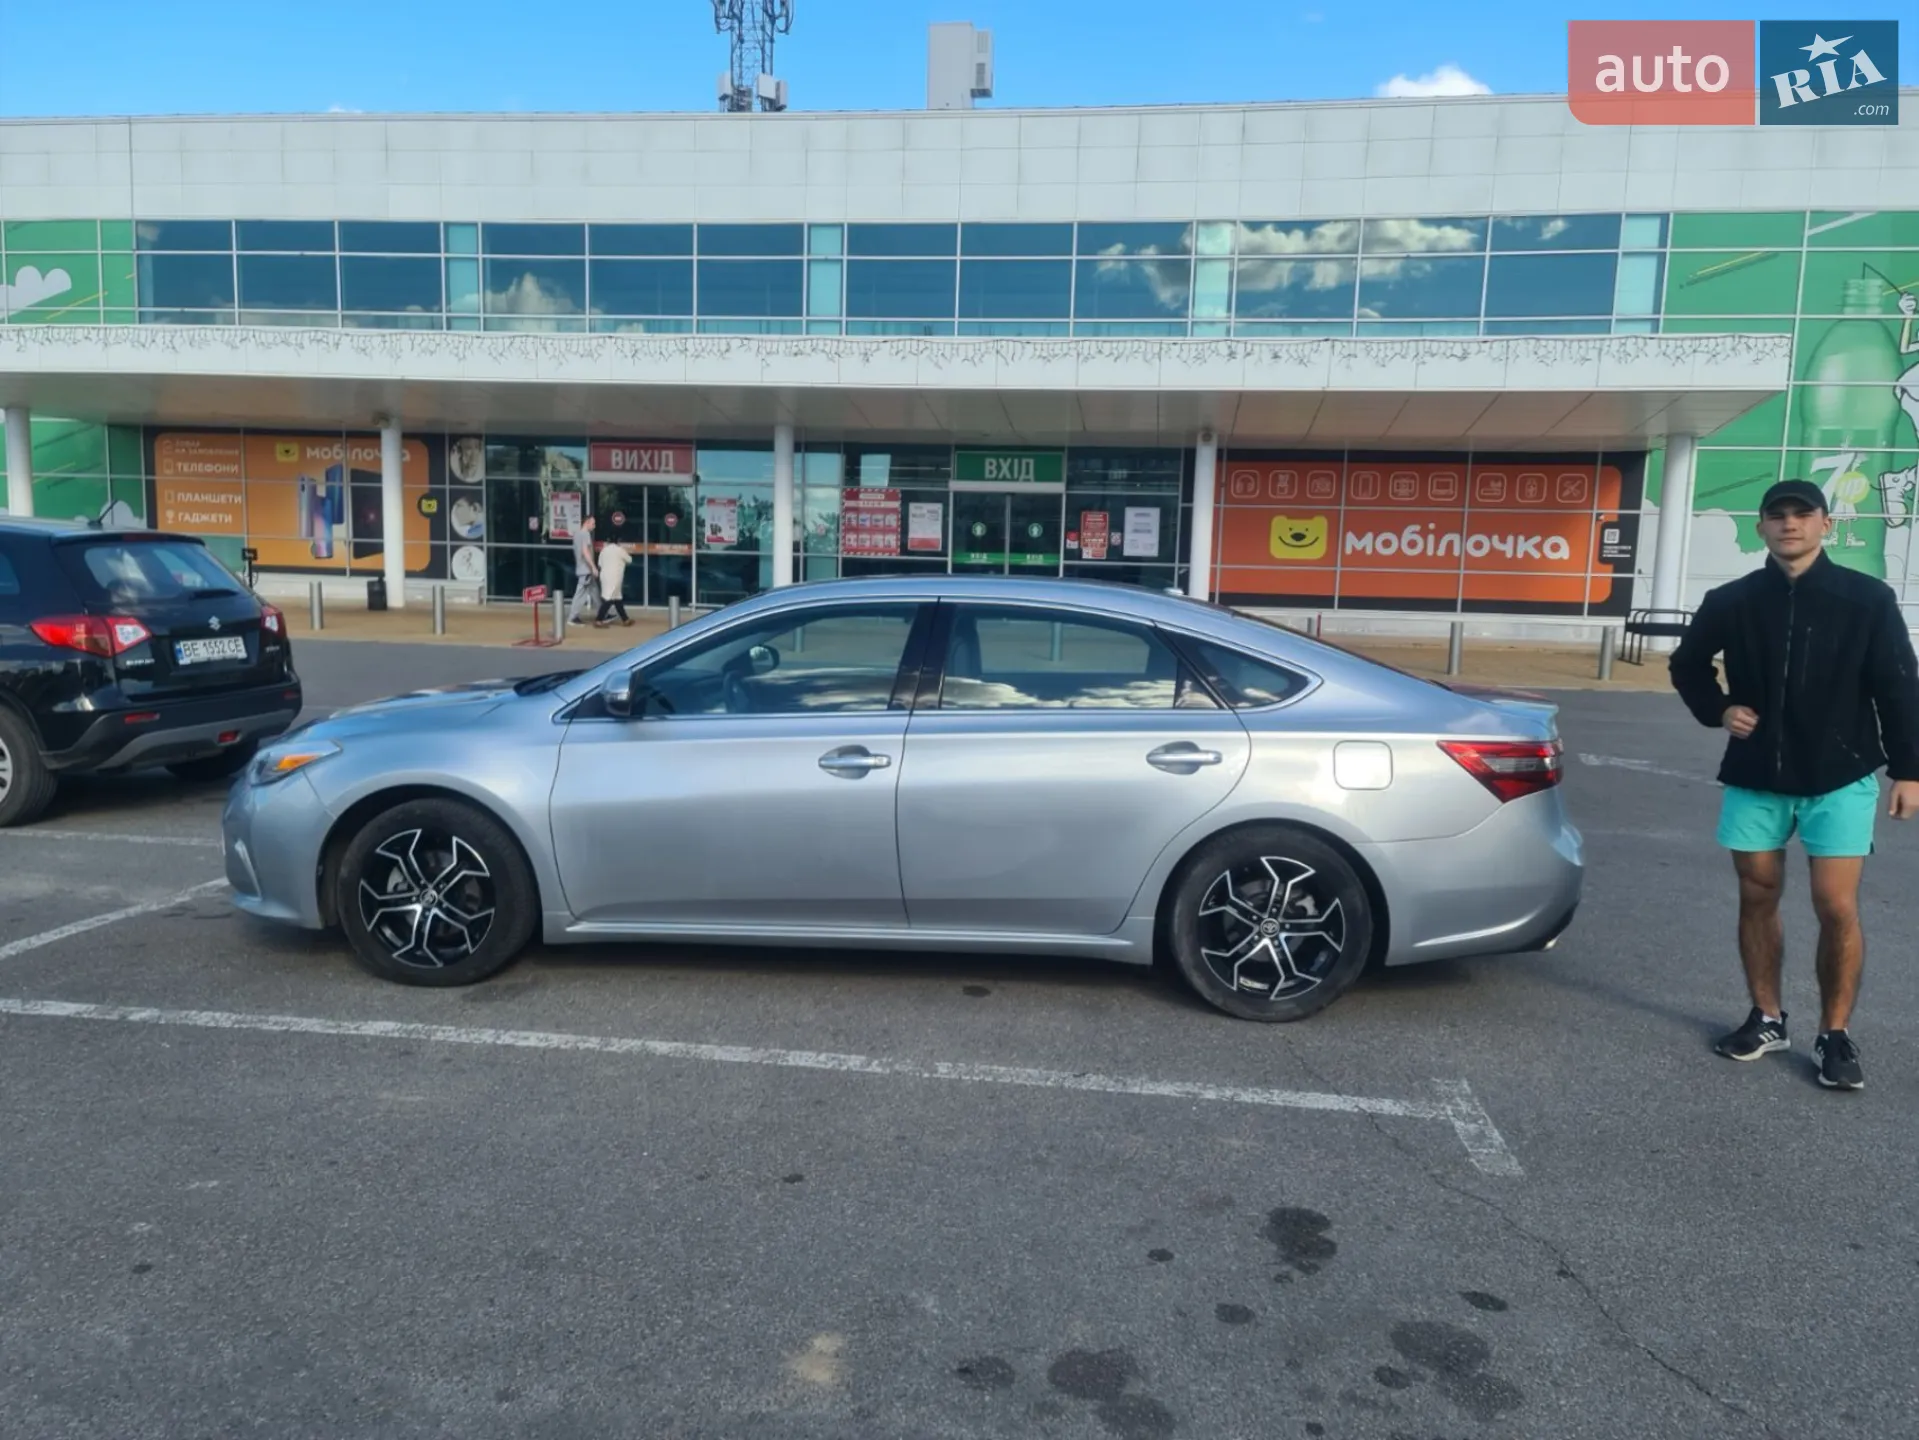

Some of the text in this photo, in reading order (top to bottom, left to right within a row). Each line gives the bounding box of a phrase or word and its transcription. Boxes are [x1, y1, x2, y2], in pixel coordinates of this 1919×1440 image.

[306, 443, 411, 463] мобілоа
[611, 449, 675, 472] ВИХІД
[177, 461, 239, 474] ТЕЛЕФОНИ
[984, 458, 1035, 482] ВХІД
[177, 492, 243, 504] ПЛАНШЕТИ
[178, 512, 232, 524] ГАДЖЕТИ
[1345, 523, 1570, 560] мобілочка
[183, 638, 243, 658] BE 1552 CE
